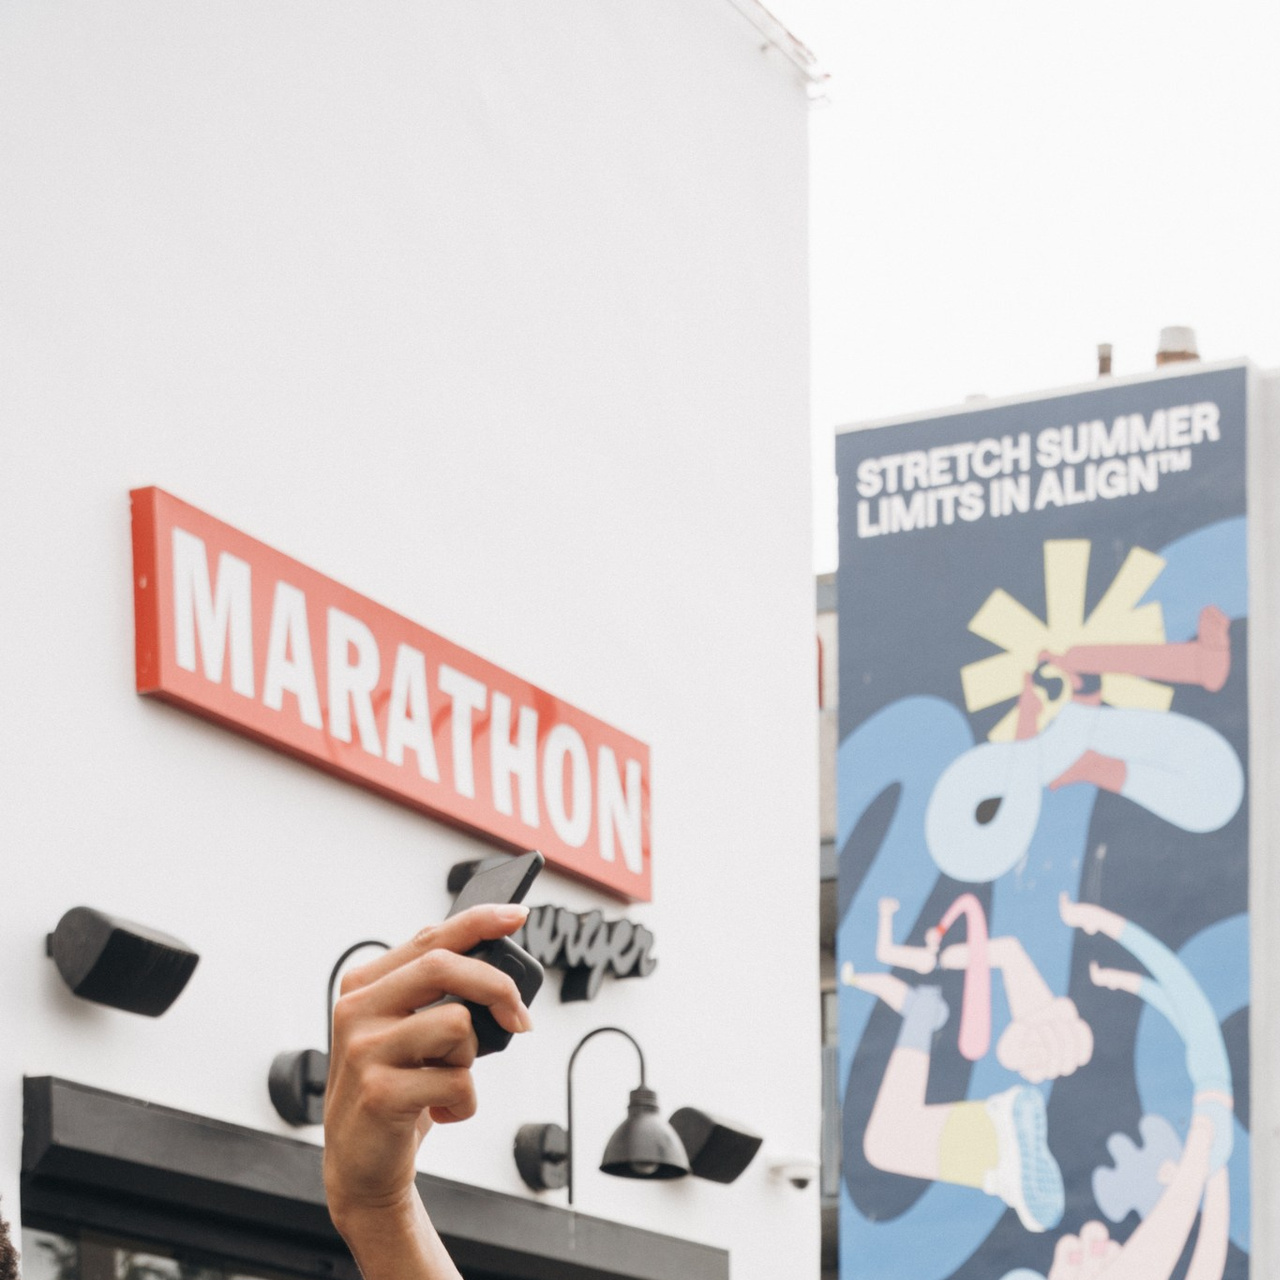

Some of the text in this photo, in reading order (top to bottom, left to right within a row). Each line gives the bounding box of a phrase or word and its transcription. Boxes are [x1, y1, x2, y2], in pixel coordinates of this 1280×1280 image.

[856, 401, 1221, 498] STRETCH SUMMER
[857, 481, 986, 538] LIMITS
[989, 473, 1031, 517] IN
[171, 525, 644, 876] MARATHON
[512, 904, 657, 1001] urger
